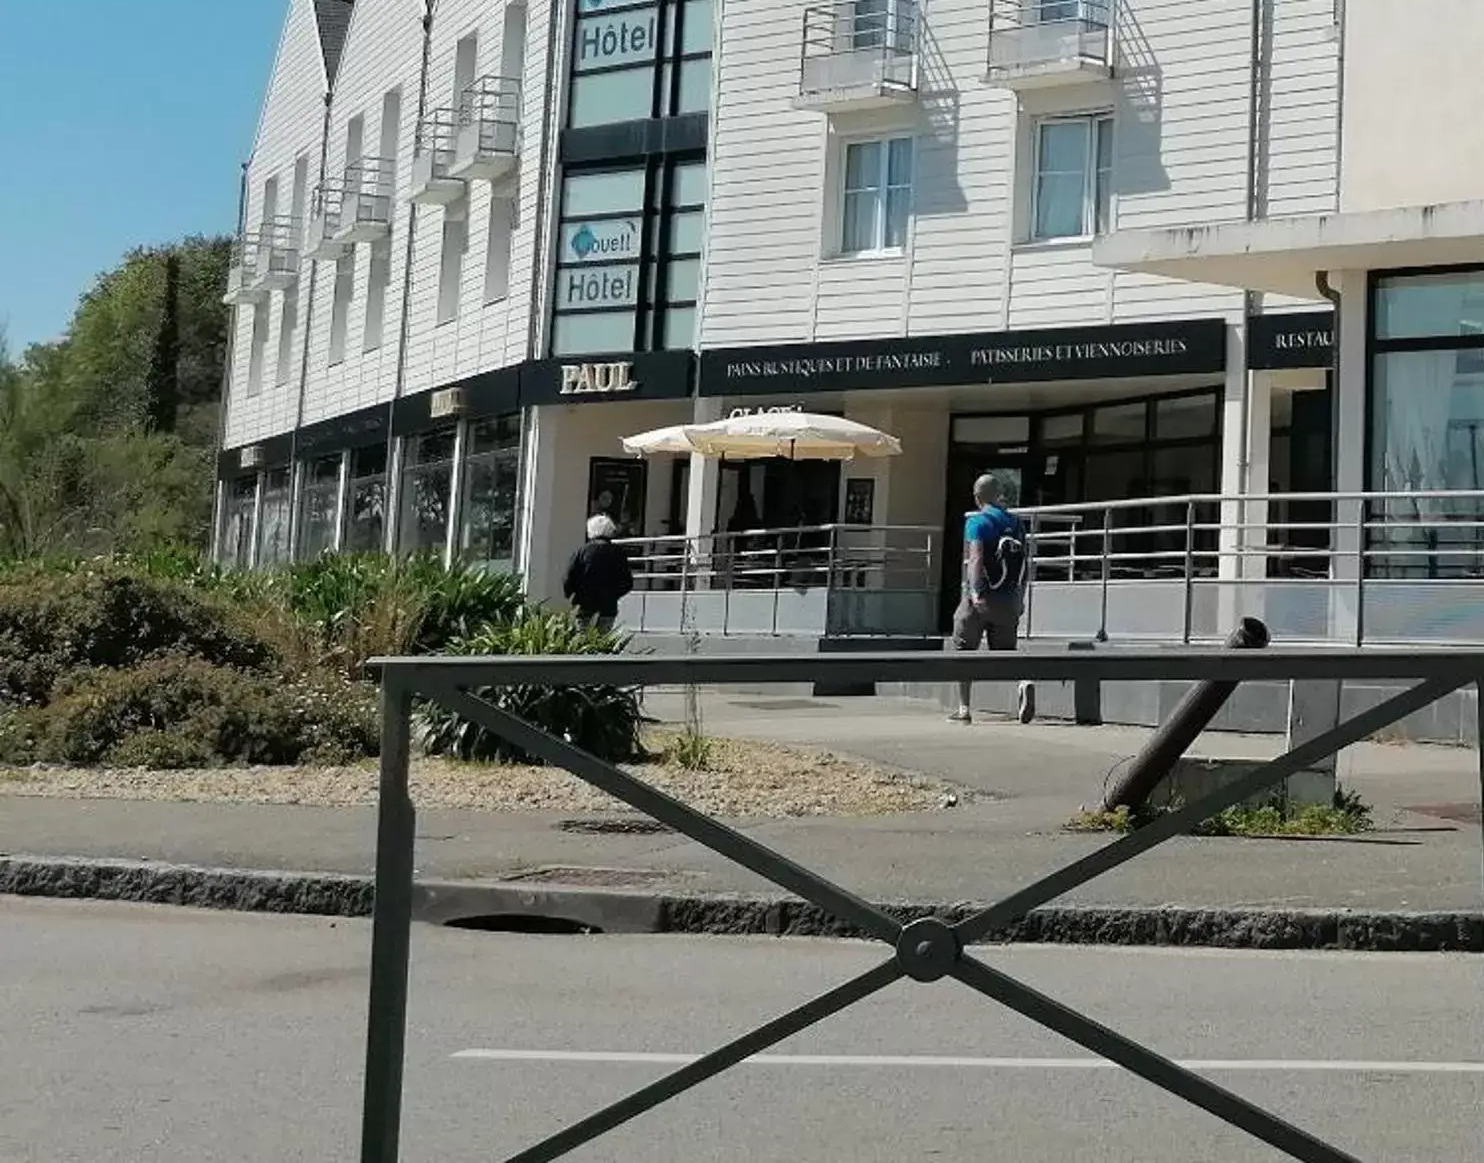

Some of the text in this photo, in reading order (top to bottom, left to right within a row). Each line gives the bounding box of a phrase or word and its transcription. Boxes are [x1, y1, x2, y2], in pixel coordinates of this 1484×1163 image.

[581, 17, 655, 60] Hôtel
[567, 270, 632, 303] Hôtel
[726, 361, 761, 378] PAINS
[763, 358, 833, 377] RUSTIQUES
[836, 356, 853, 373] ET
[856, 356, 873, 371] DE
[876, 352, 940, 371] FANTAISIE
[1056, 345, 1072, 360] ET
[1076, 339, 1188, 359] VIENNOISERIES
[559, 361, 639, 394] PAUL
